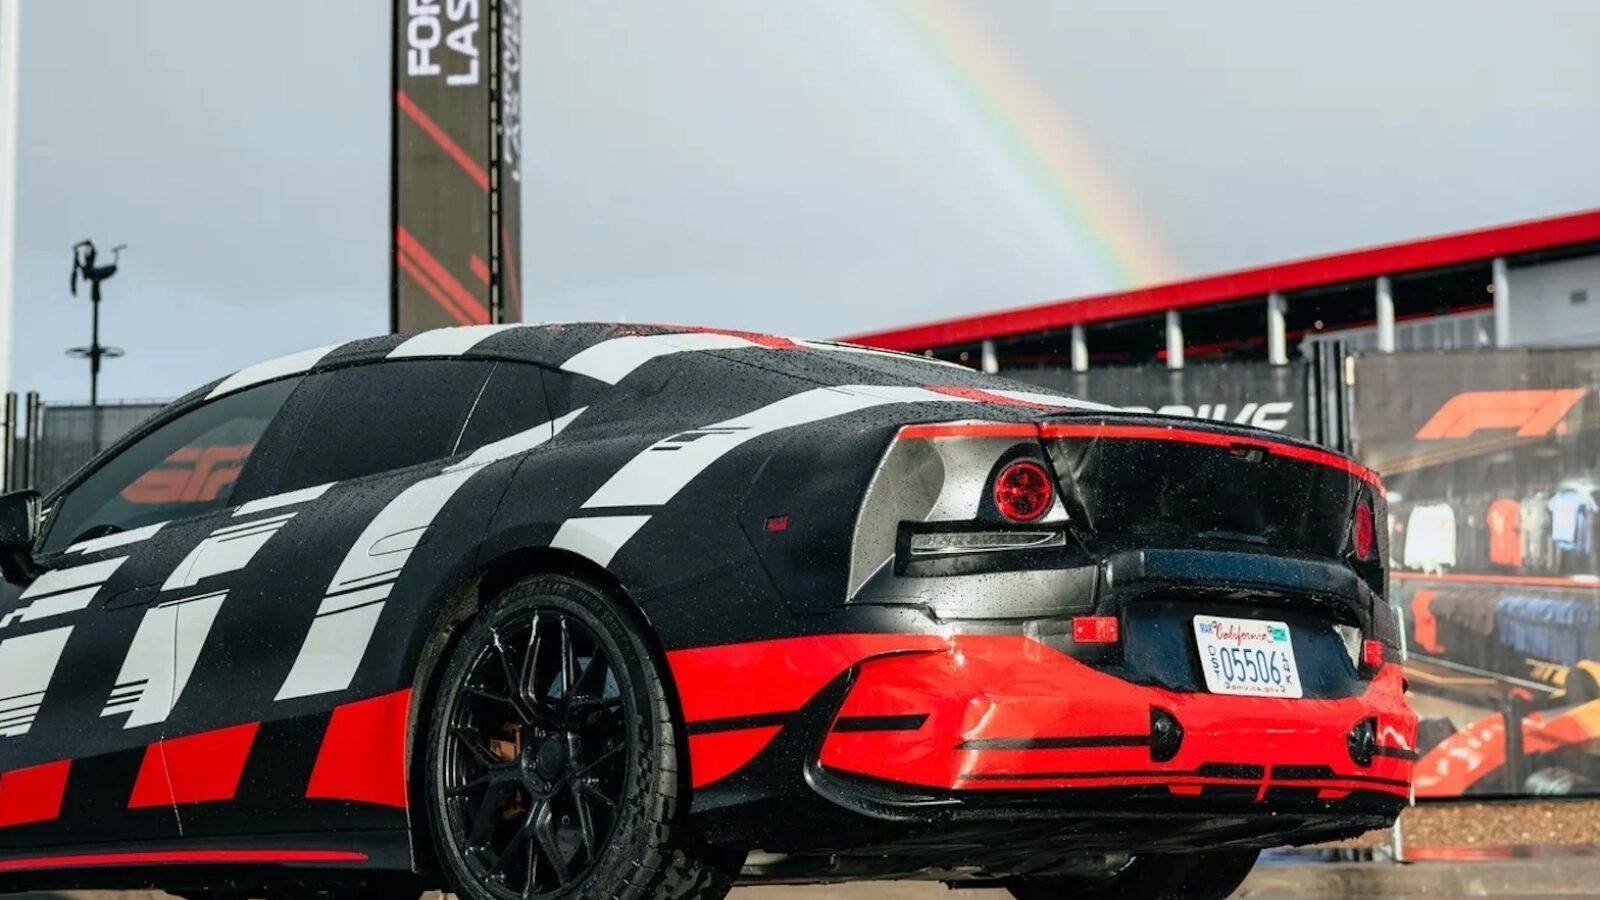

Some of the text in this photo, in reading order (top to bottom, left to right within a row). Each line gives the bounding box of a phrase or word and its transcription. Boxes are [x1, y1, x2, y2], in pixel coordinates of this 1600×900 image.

[446, 0, 479, 86] LAS
[1200, 623, 1213, 634] MAR
[1214, 622, 1274, 646] California
[1220, 647, 1281, 685] 05506
[1231, 684, 1279, 693] dmv.ca.gov
